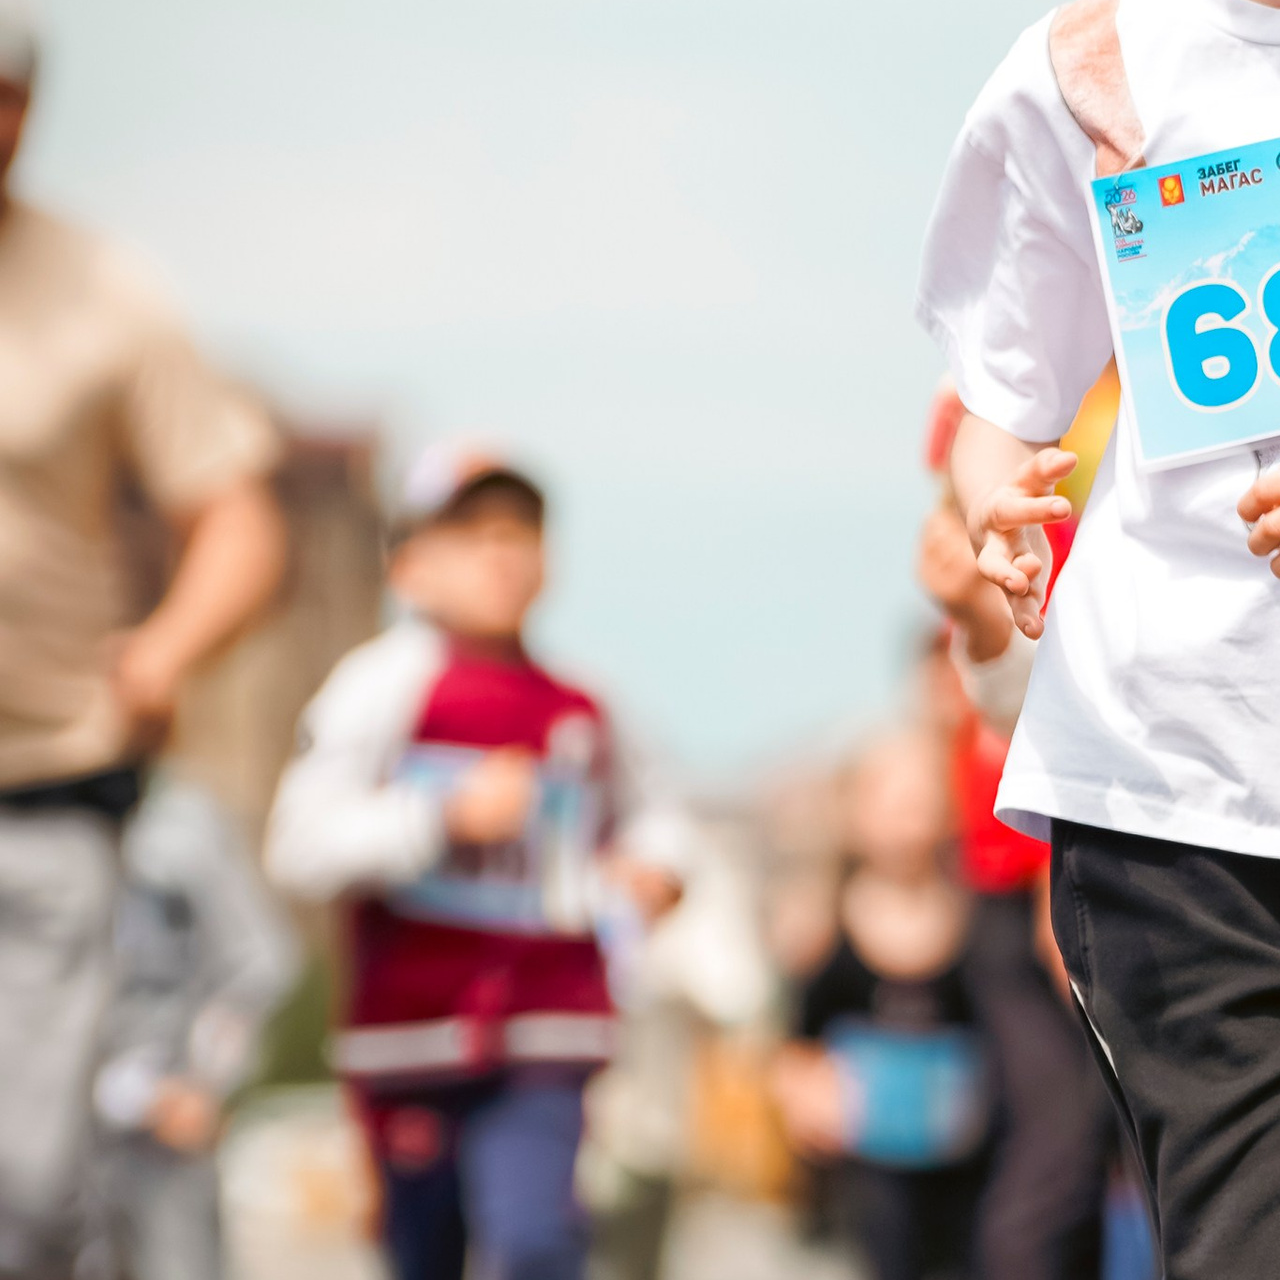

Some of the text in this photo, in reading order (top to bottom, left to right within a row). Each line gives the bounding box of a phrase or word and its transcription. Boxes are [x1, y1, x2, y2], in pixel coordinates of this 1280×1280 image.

[1197, 159, 1241, 180] ЗАБЕГ
[1200, 168, 1263, 197] МАГАС
[1105, 189, 1136, 205] 2026
